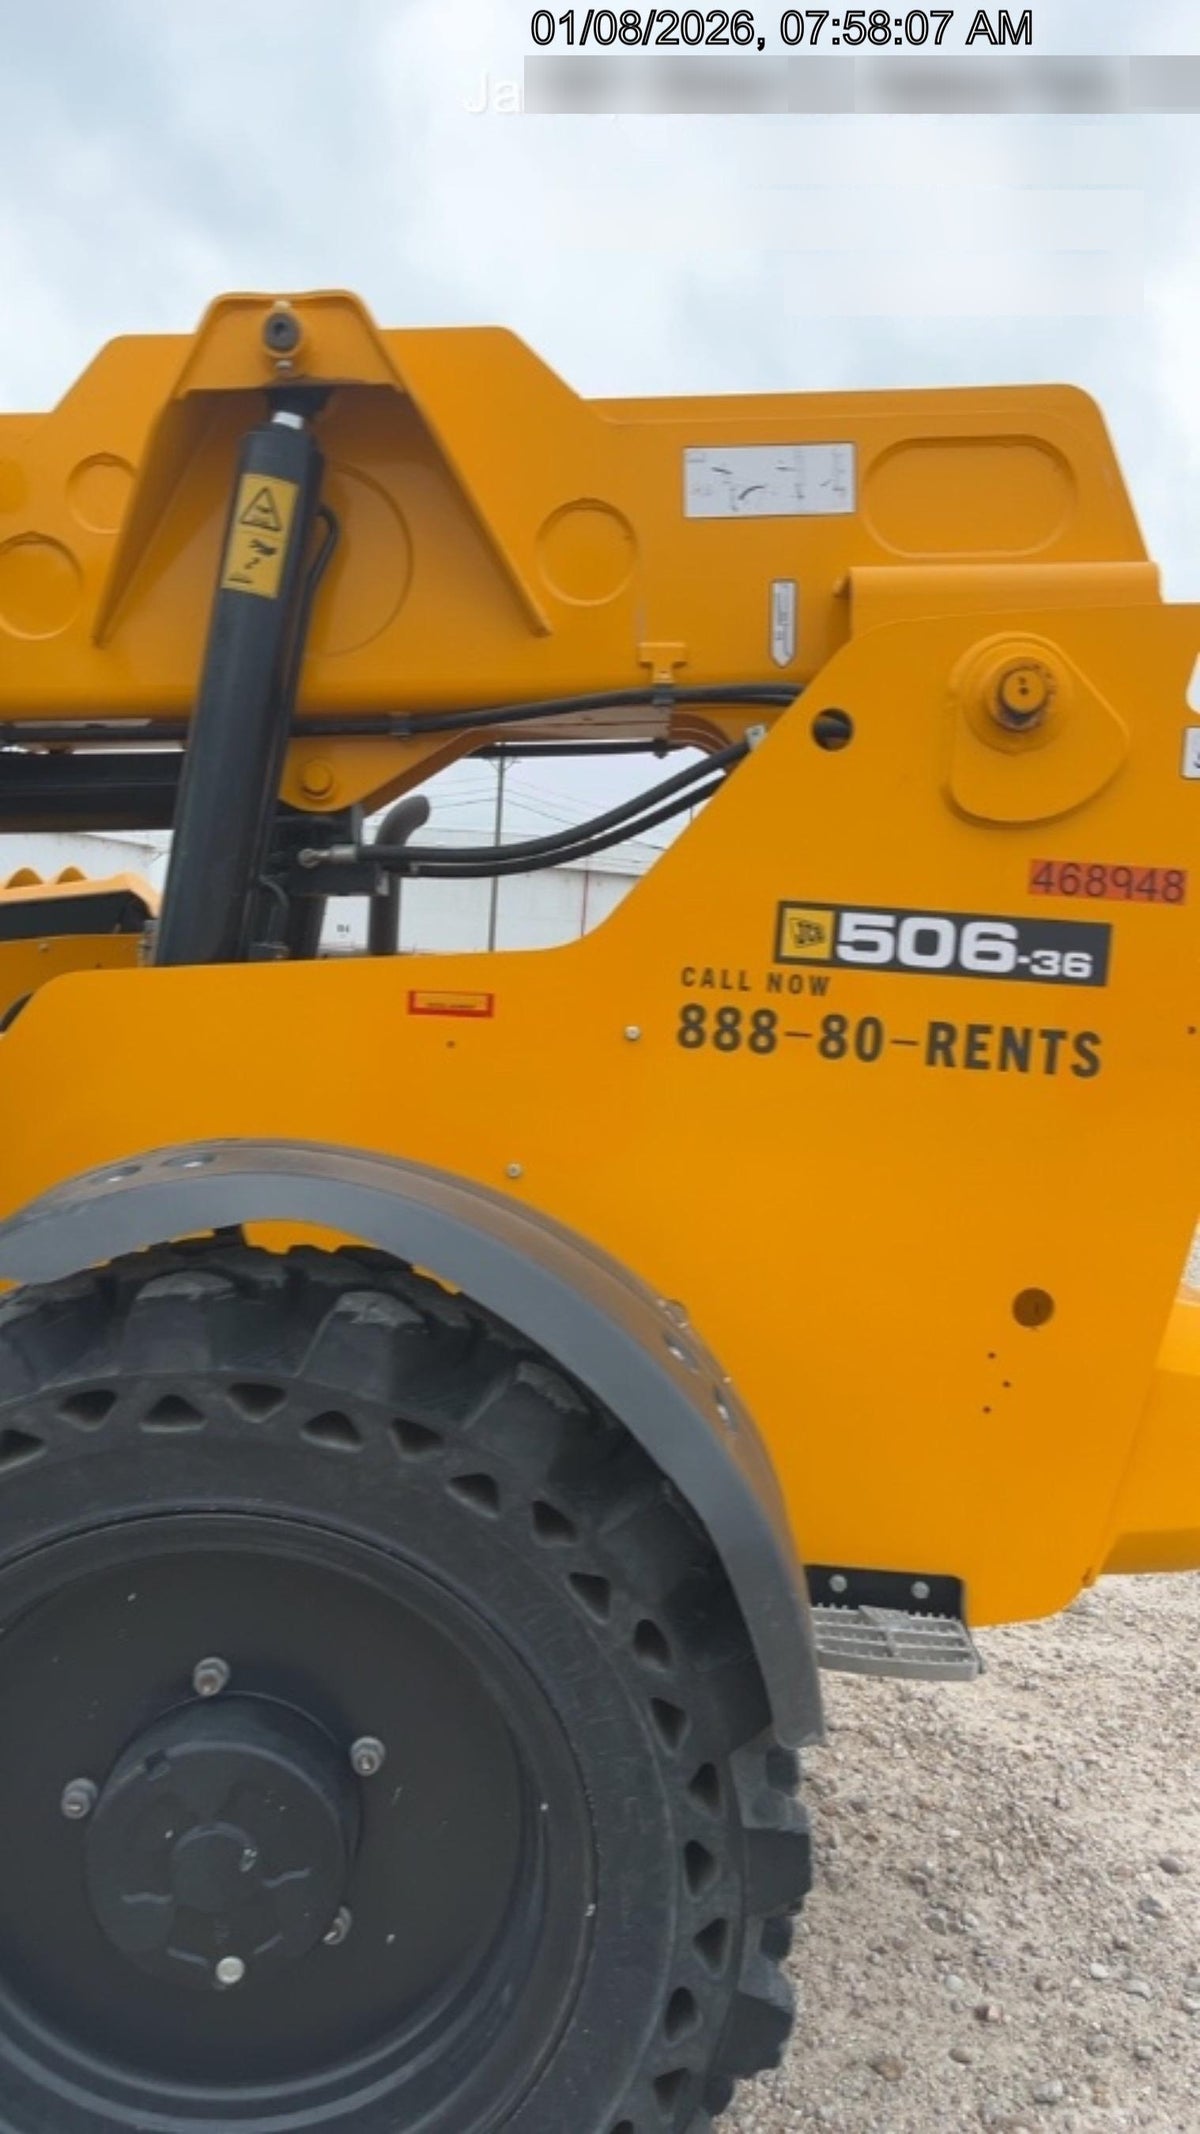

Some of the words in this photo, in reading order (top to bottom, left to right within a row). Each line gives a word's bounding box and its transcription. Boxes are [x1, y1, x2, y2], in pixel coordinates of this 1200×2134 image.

[1031, 860, 1186, 904] 468948
[681, 966, 752, 991] CALL
[766, 973, 831, 997] NOW
[677, 1002, 1103, 1078] 888-80-RENTS
